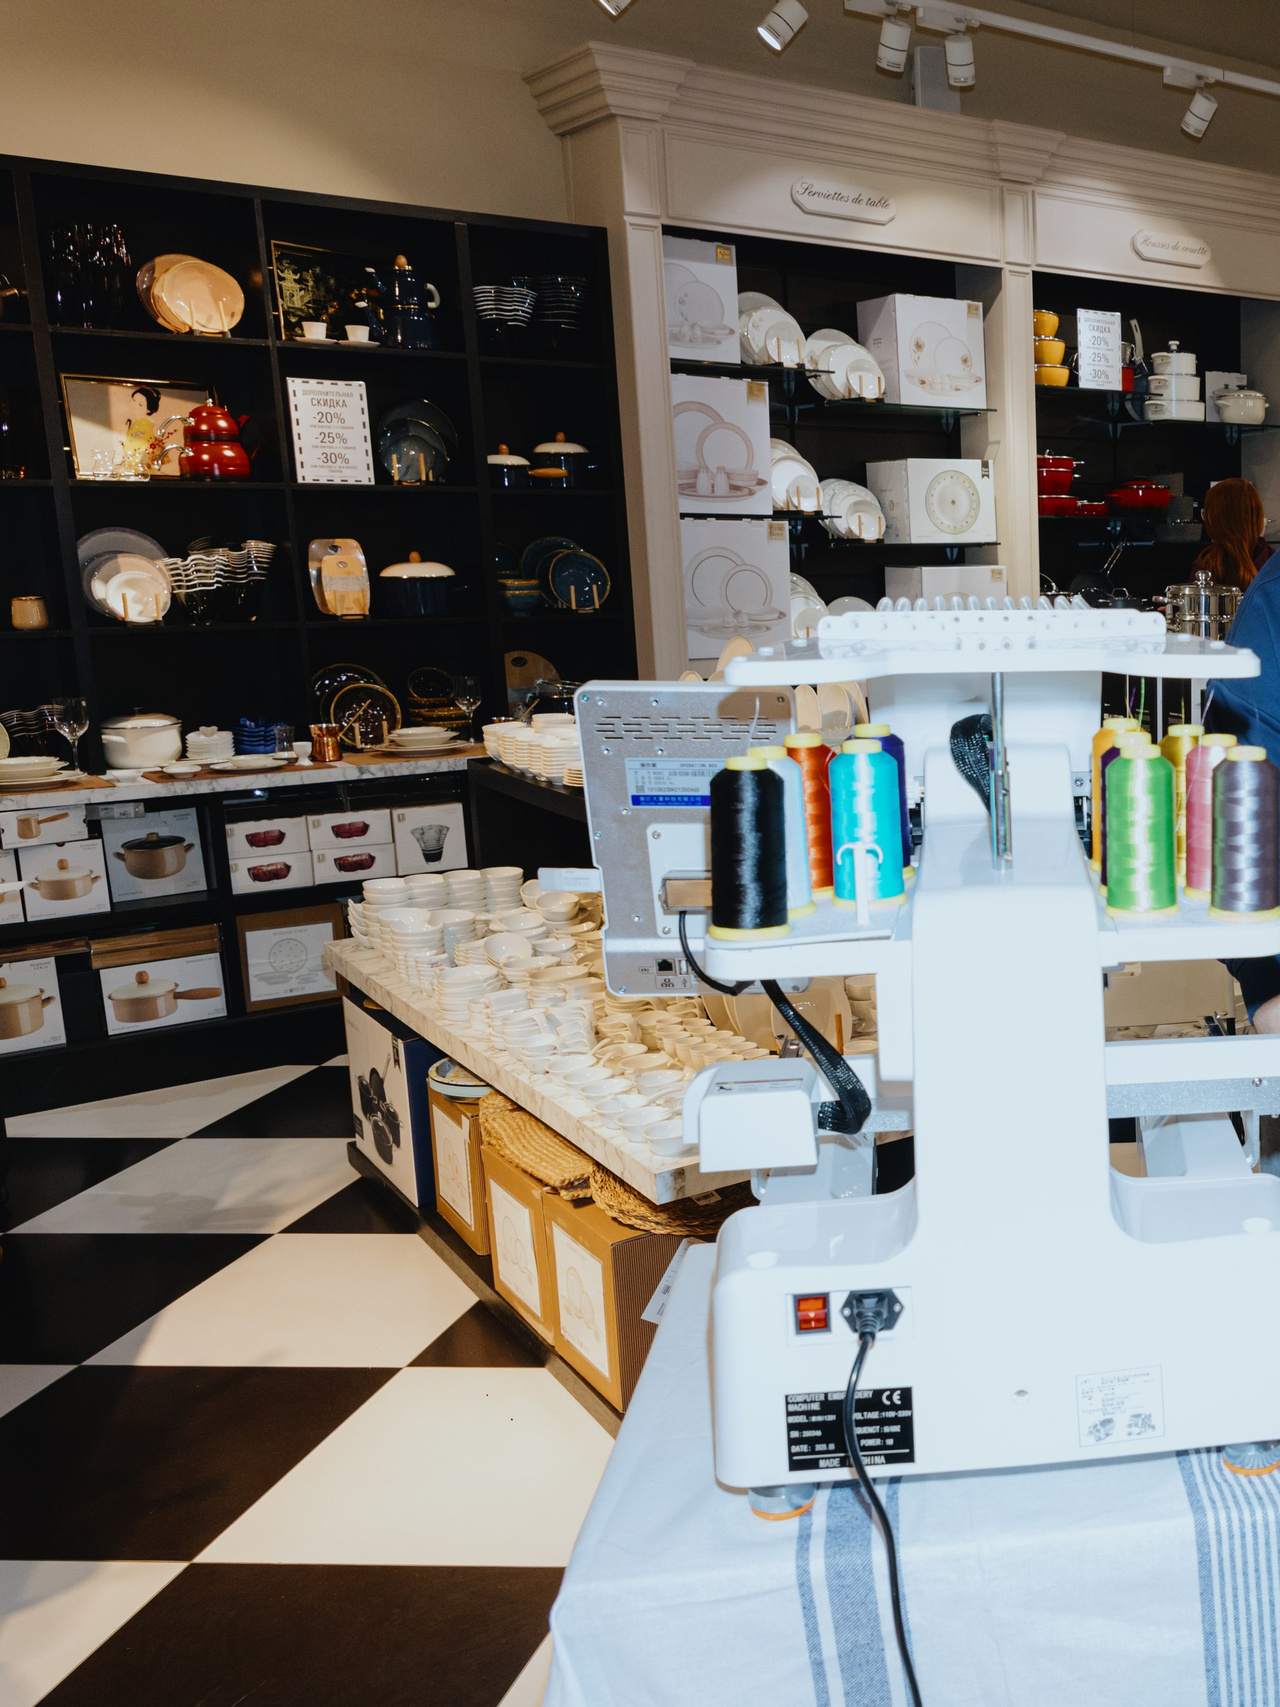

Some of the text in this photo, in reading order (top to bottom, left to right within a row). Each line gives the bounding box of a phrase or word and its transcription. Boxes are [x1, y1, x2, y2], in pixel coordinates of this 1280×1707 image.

[797, 182, 891, 209] Serviettes de table
[1141, 234, 1207, 255] Housses de couette
[1089, 324, 1111, 333] СКИДКА
[1089, 335, 1109, 347] -20%
[1089, 352, 1109, 363] -25%
[1089, 369, 1109, 380] -30%
[302, 389, 353, 398] ДОПОЛНИТЕЛЬНАЯ
[311, 398, 347, 408] СКИДКА
[313, 411, 345, 424] -20%
[315, 432, 347, 444] -25%
[317, 452, 349, 464] -30%
[787, 1393, 825, 1403] COMPUTER
[787, 1402, 821, 1411] MACHINE
[791, 1444, 811, 1453] DATE:
[819, 1458, 840, 1468] MADE
